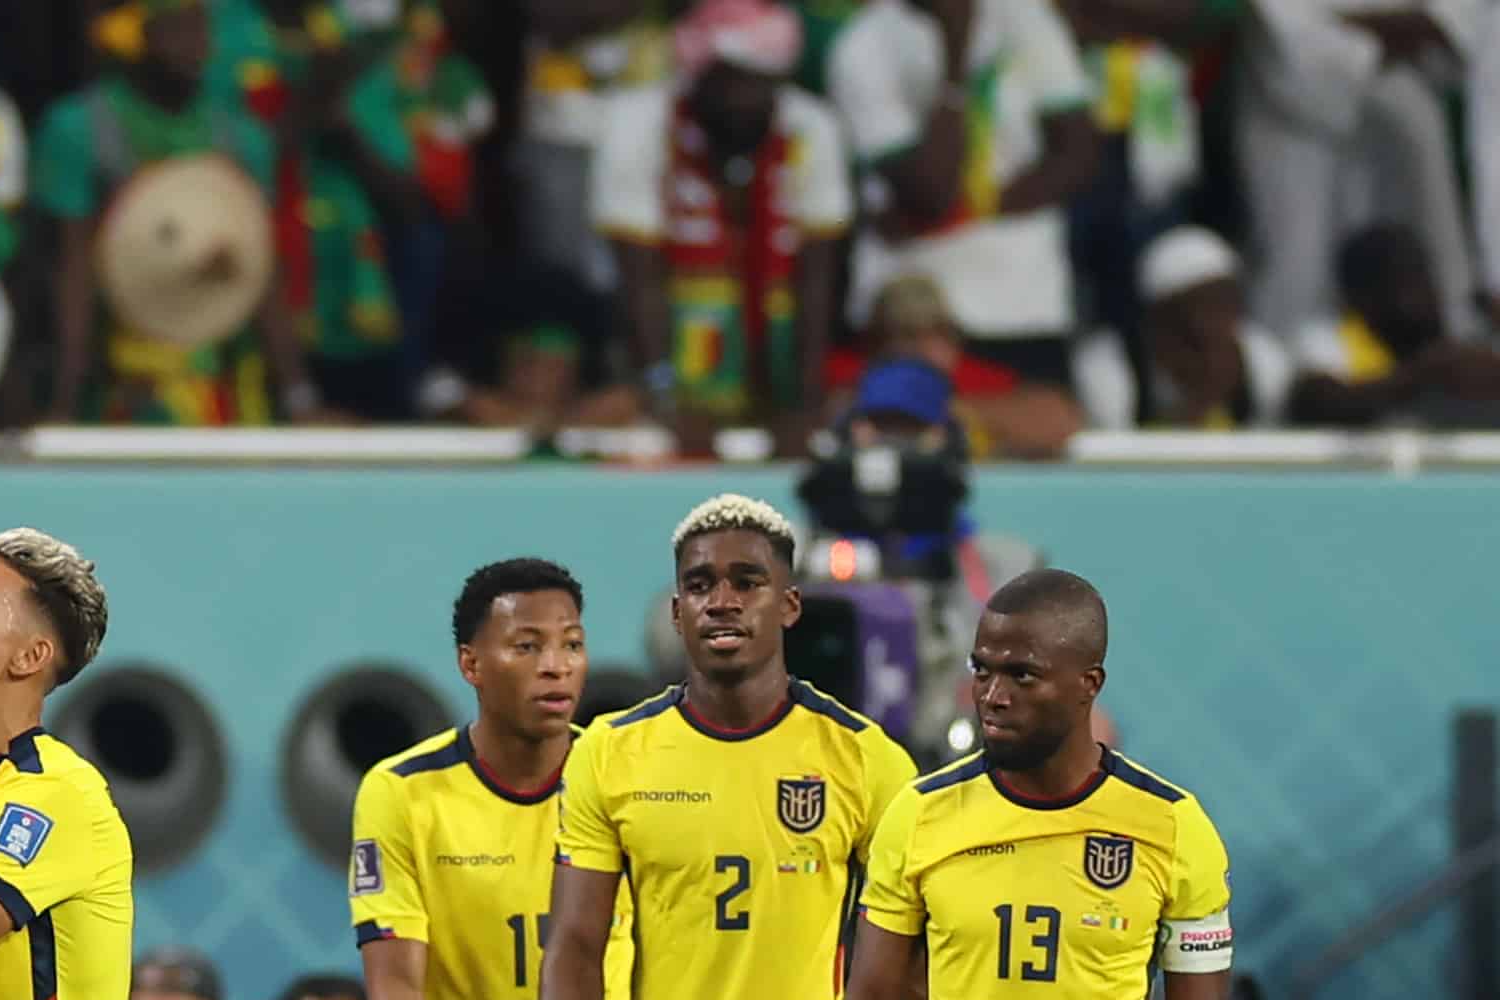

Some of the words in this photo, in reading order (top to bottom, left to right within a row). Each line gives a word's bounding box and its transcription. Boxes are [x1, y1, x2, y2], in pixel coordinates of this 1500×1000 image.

[632, 789, 712, 803] marathon
[436, 853, 516, 866] marathon
[713, 855, 751, 931] 2
[993, 903, 1062, 983] 13
